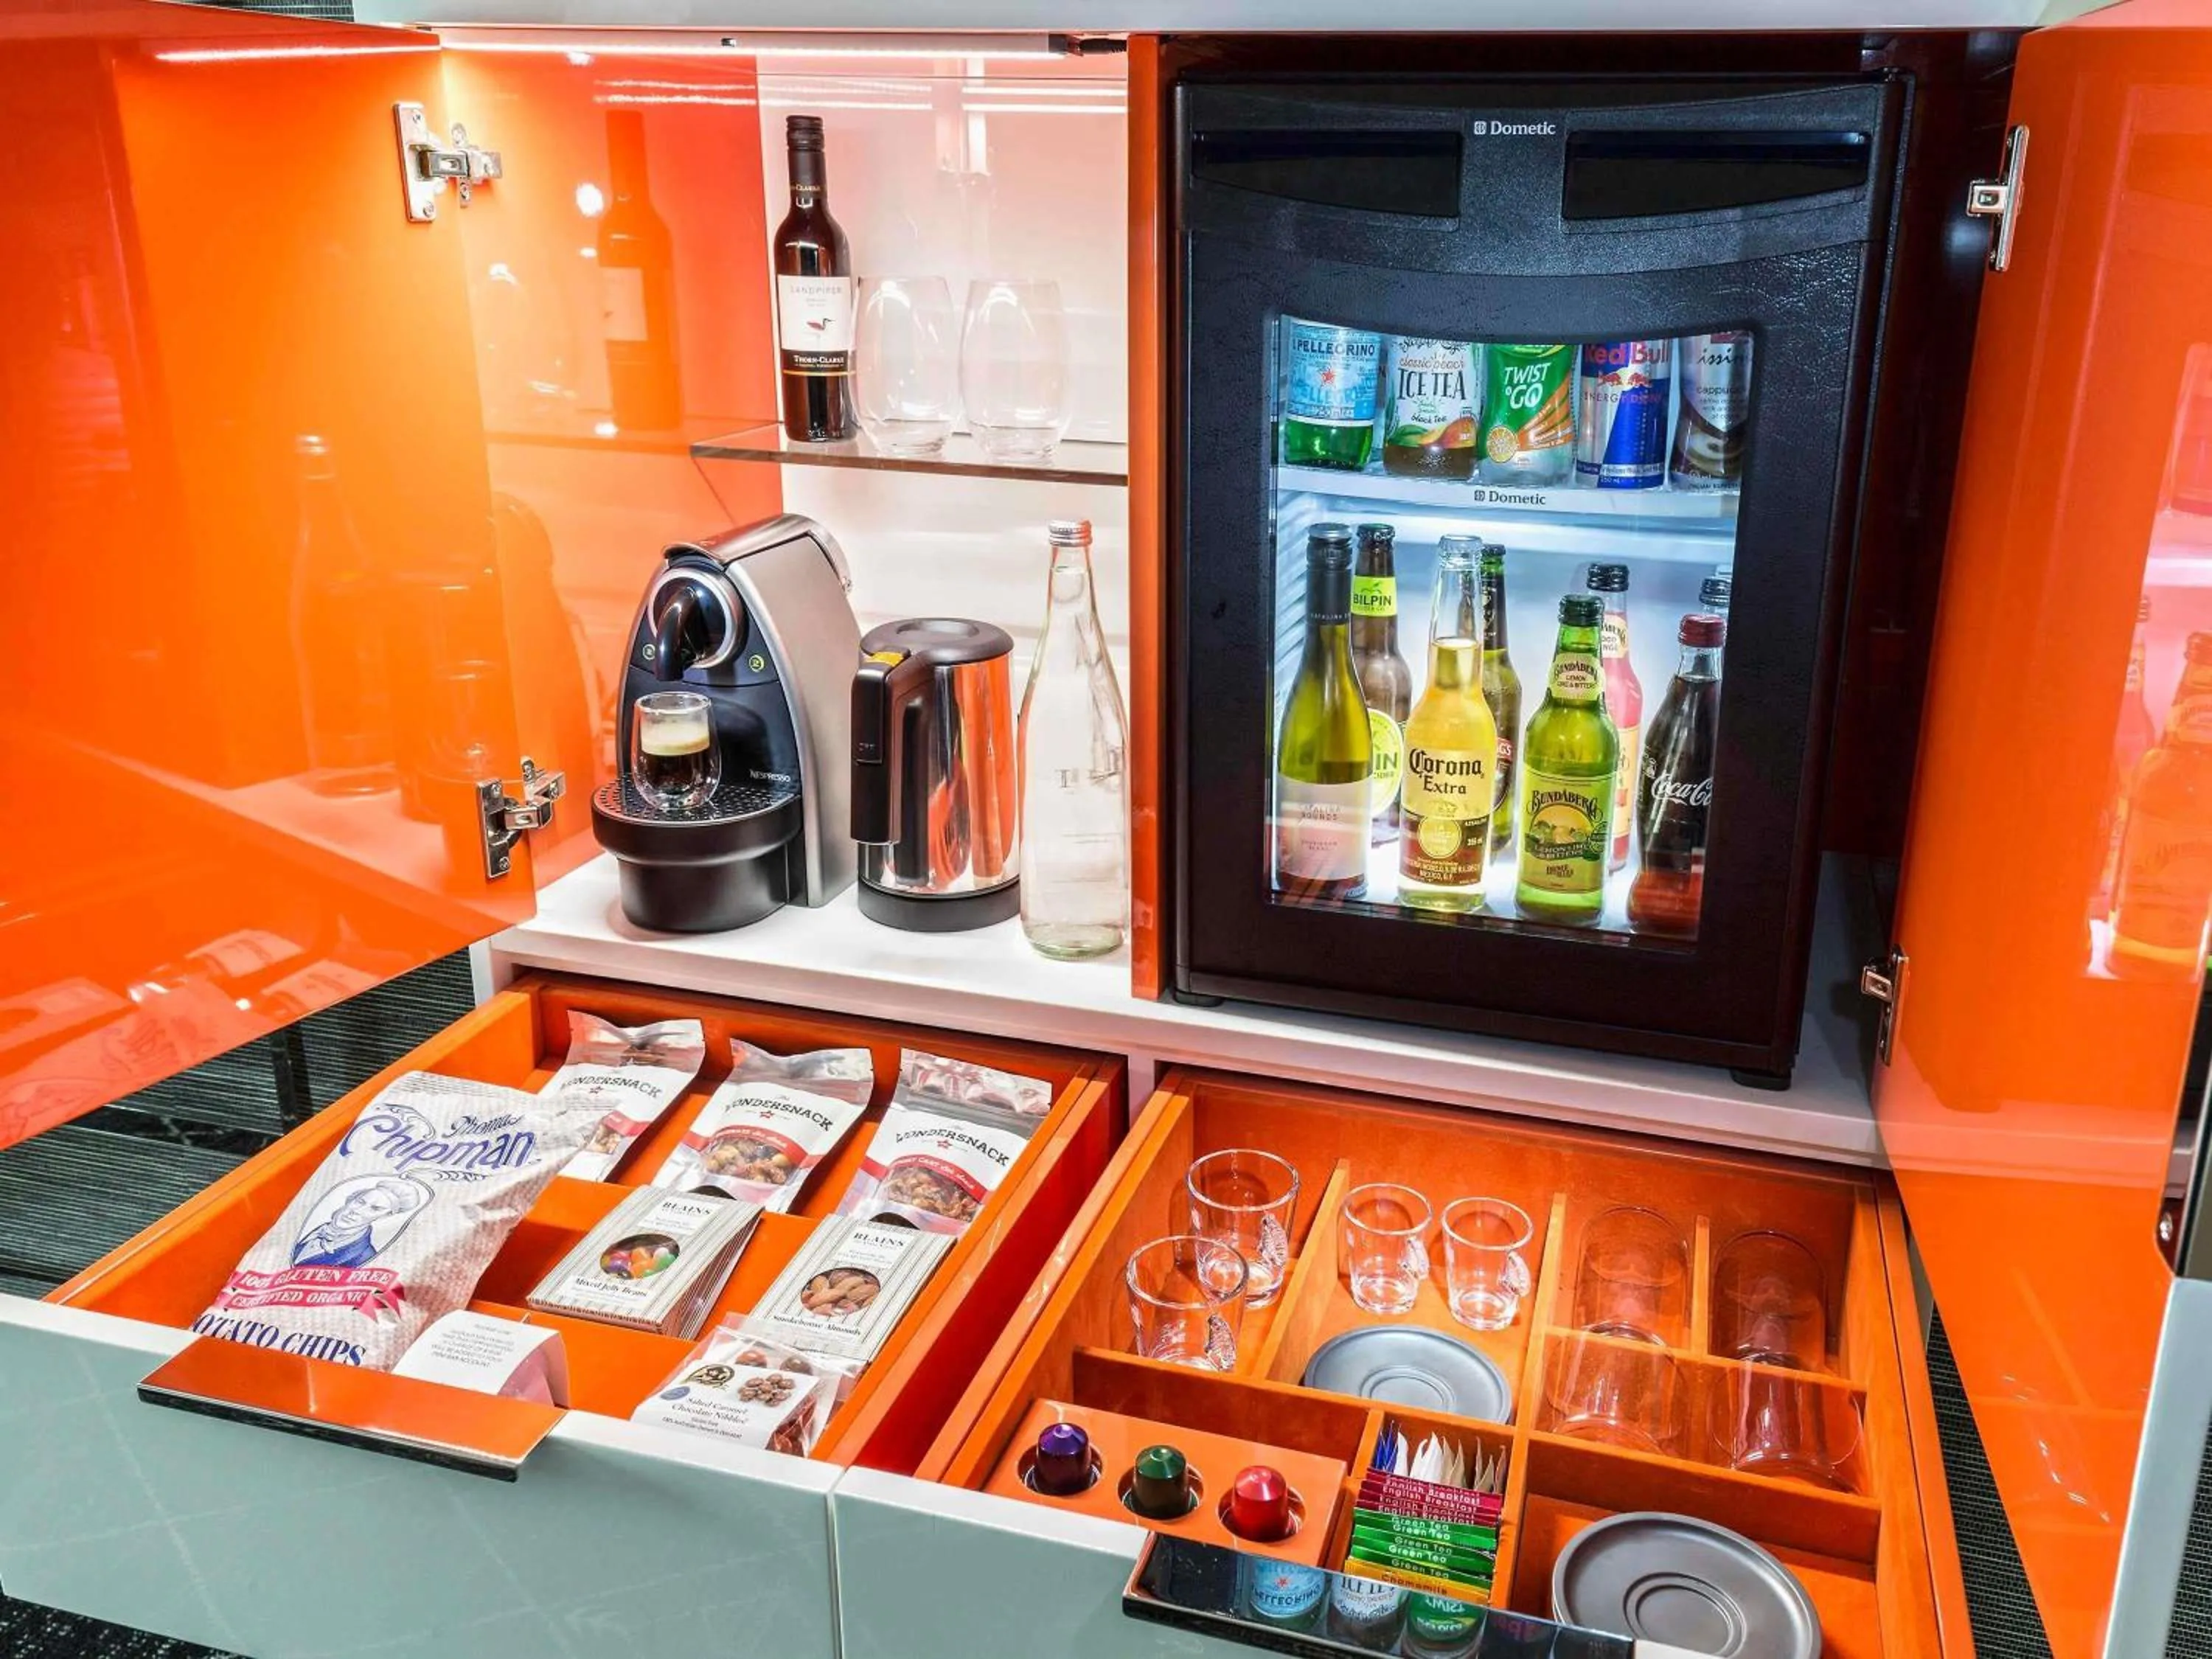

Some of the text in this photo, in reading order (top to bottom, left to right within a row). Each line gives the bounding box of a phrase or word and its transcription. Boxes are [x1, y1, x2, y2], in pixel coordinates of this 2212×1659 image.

[1489, 120, 1557, 135] Dometic
[1585, 341, 1670, 365] Red Bull
[1397, 367, 1467, 400] ICE TEA
[1504, 362, 1551, 385] TWIST
[1510, 383, 1543, 409] GO
[1489, 490, 1546, 505] Dometic
[1353, 594, 1392, 606] BILPIN
[1409, 748, 1483, 776] Corona
[749, 769, 791, 782] NESPRESSO
[1422, 773, 1467, 794] Extra
[1528, 789, 1601, 820] BUNDABERG
[442, 1113, 526, 1138] Thomas
[339, 1114, 536, 1172] Chipman
[663, 1201, 711, 1215] BLAINS
[854, 1232, 904, 1247] BLAINS
[274, 1266, 344, 1286] GLUTEN
[347, 1269, 392, 1284] FREE
[231, 1290, 367, 1305] CERTIFIED ORGANIC
[576, 1278, 602, 1288] Mixed
[599, 1283, 619, 1292] Jelly
[622, 1287, 647, 1297] Beans
[192, 1312, 366, 1366] OTATO CHIPS
[825, 1324, 860, 1335] Almonds
[672, 1403, 713, 1416] Chocolate
[713, 1403, 748, 1415] Caramel
[1382, 1485, 1422, 1501] English
[1425, 1495, 1477, 1513] Breakfast
[1385, 1477, 1425, 1494] English
[1427, 1488, 1481, 1506] Breakfast
[1377, 1505, 1475, 1525] English Breakfast
[1379, 1495, 1475, 1520] English Breakfast
[1391, 1516, 1450, 1531] Green Tea
[1392, 1523, 1451, 1540] Green Tea
[1388, 1544, 1447, 1564] Green Tea
[1394, 1536, 1453, 1555] Green Tea
[1391, 1558, 1450, 1579] Green Tea
[1381, 1573, 1448, 1594] Chamomile
